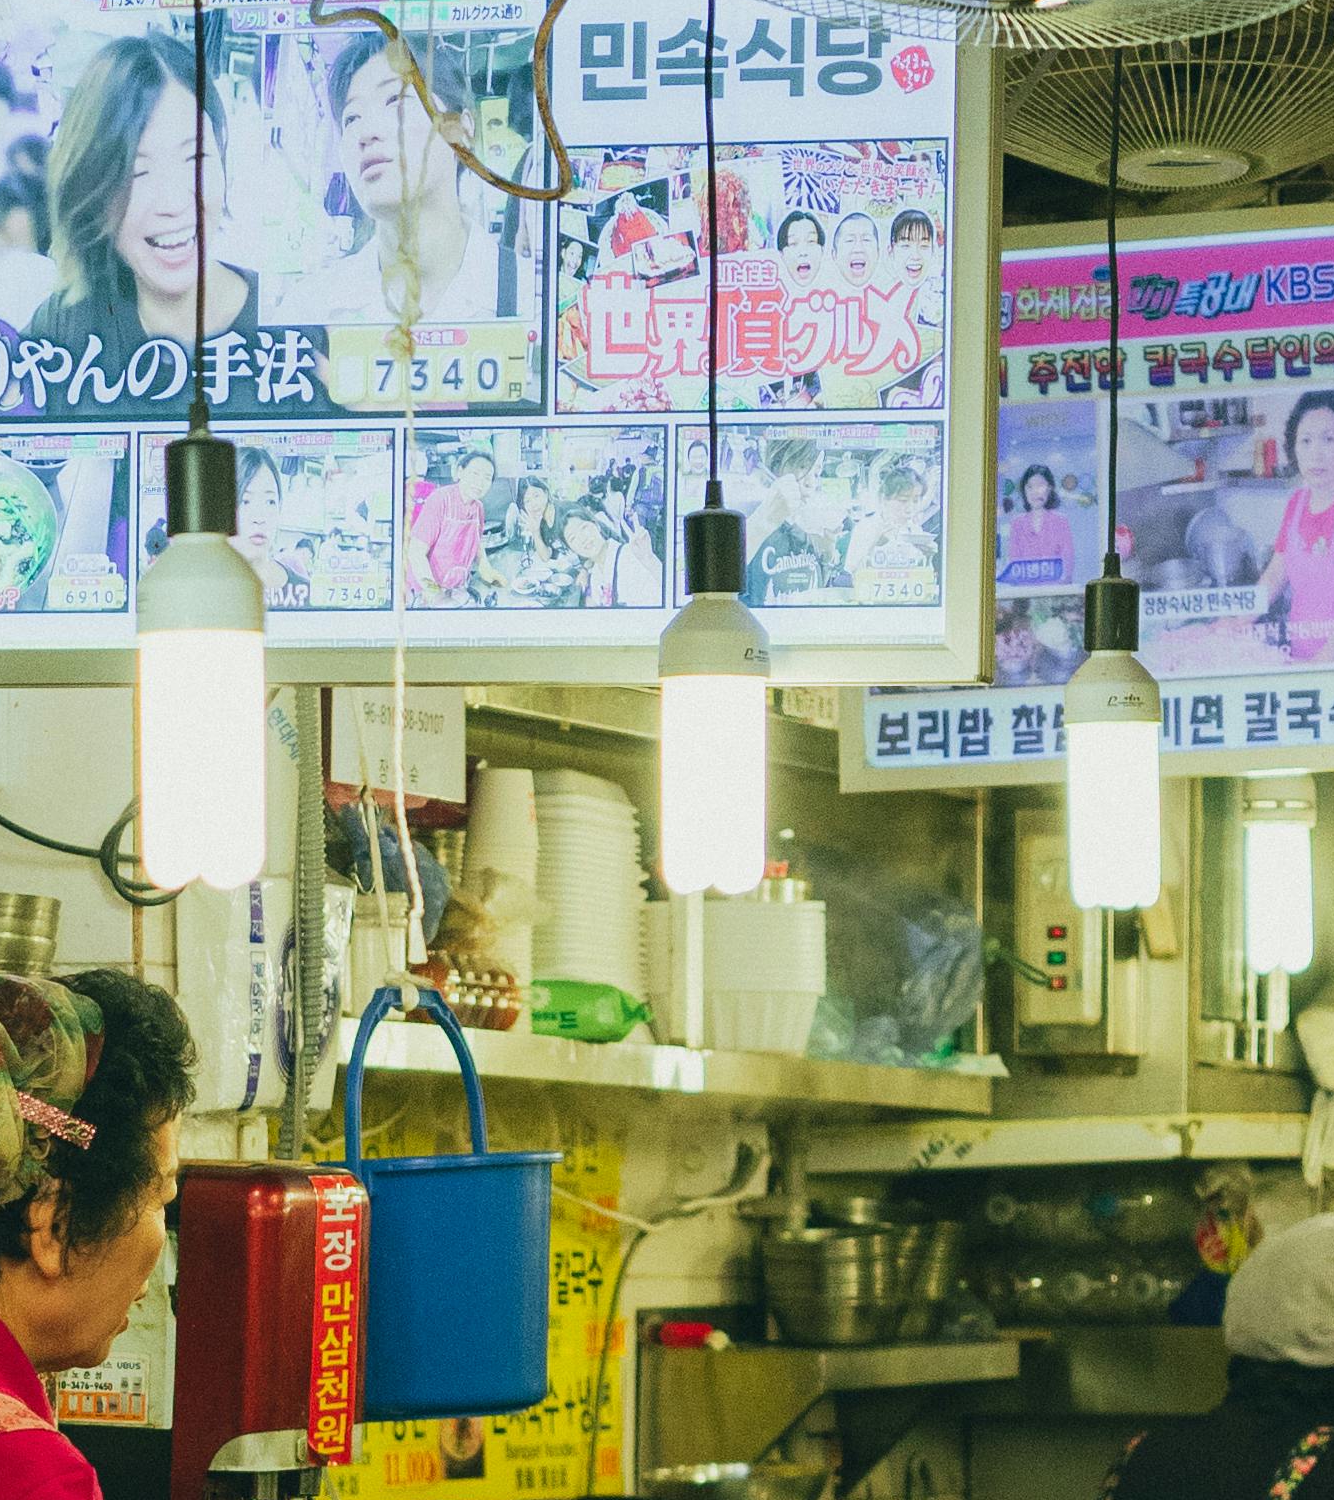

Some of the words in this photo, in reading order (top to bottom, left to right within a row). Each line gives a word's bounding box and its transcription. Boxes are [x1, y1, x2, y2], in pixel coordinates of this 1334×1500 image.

[579, 15, 891, 101] 민속식당
[1028, 349, 1126, 395] 추천한
[66, 592, 115, 605] 6910
[327, 588, 377, 602] 7340
[873, 584, 924, 597] 7340
[877, 706, 993, 759] 보리밥
[314, 1281, 355, 1455] 만삼천원
